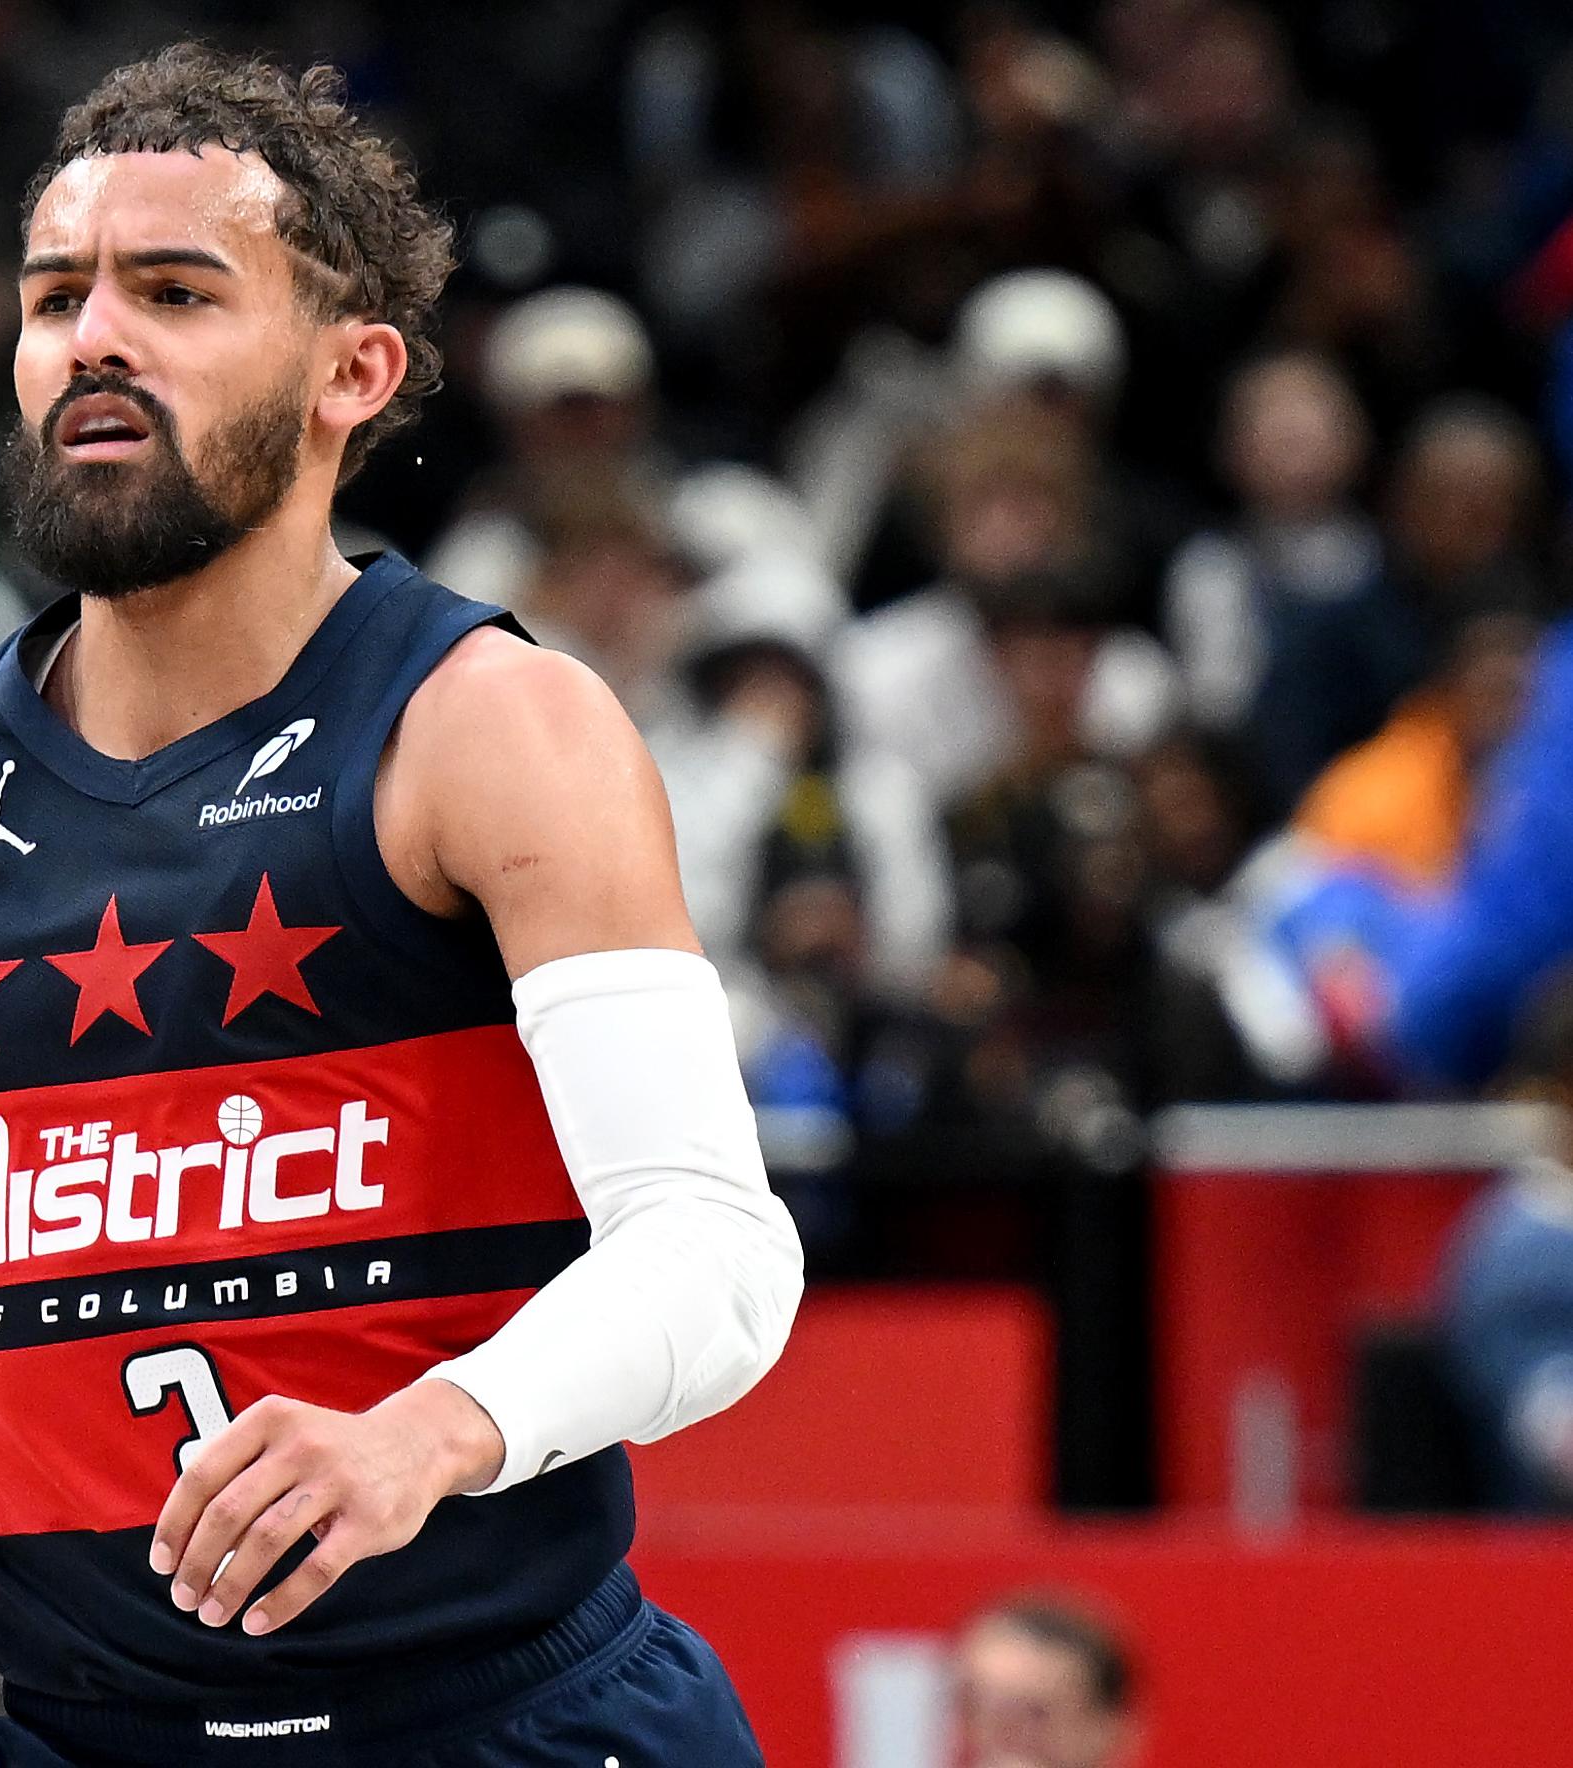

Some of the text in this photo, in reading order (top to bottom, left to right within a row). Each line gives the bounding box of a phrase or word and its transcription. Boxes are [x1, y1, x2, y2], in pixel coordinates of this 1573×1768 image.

[198, 786, 322, 827] Robinhood
[39, 1121, 112, 1161] THE
[40, 1260, 391, 1323] COLUMBIA
[205, 1714, 330, 1738] WASHINGTON
